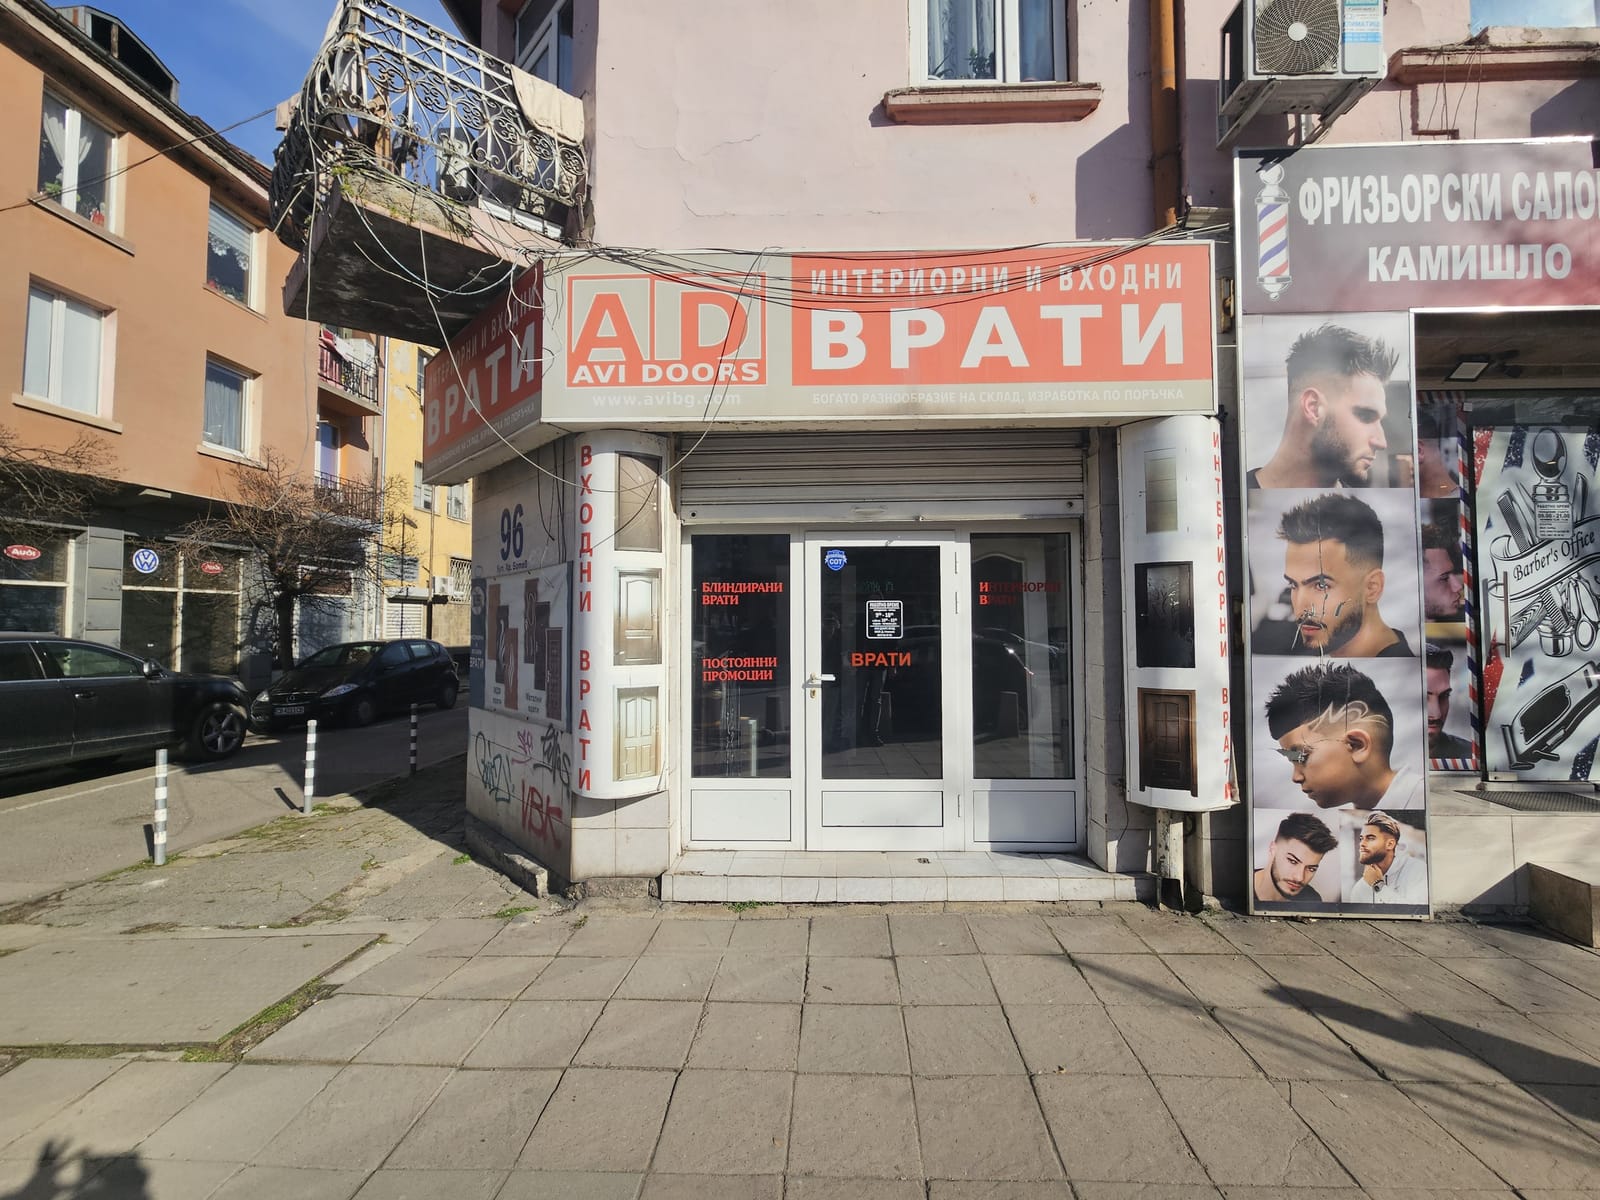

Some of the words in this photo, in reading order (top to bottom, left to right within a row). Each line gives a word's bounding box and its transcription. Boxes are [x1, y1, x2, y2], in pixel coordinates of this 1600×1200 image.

[1299, 172, 1503, 225] ФРИЗЬОРСКИ
[811, 266, 1009, 296] ИНТЕРИОРНИ
[1026, 265, 1041, 292] И
[1059, 262, 1182, 295] ВХОДНИ
[1368, 243, 1572, 282] КАМИШЛО
[811, 302, 1184, 370] ВРАТИ
[427, 321, 536, 447] ВРАТИ
[572, 364, 625, 384] AVI
[641, 361, 760, 383] DOORS
[592, 391, 740, 408] www.avibg.com
[813, 393, 859, 405] БОГАТО
[862, 391, 956, 404] РАЗНООБРАЗИЕ
[960, 391, 977, 402] НА
[1028, 390, 1099, 402] ИЗРАБОТКА
[1103, 389, 1121, 400] ПО
[1125, 388, 1184, 400] ПОРЪЧКА
[500, 503, 524, 561] 96
[578, 445, 593, 613] ВХОДНИ
[1212, 431, 1228, 658] ИНТЕРИОРНИ
[11, 548, 36, 557] Audi
[1513, 548, 1559, 581] Barber's
[1561, 531, 1595, 560] Office
[702, 582, 783, 594] БЛИНДИРАНИ
[702, 595, 739, 605] ВРАТИ
[702, 657, 777, 668] ПОСТОЯННИ
[703, 669, 773, 681] ПРОМОЦИИ
[851, 652, 911, 667] ВРАТИ
[578, 649, 593, 792] ВРАТИ
